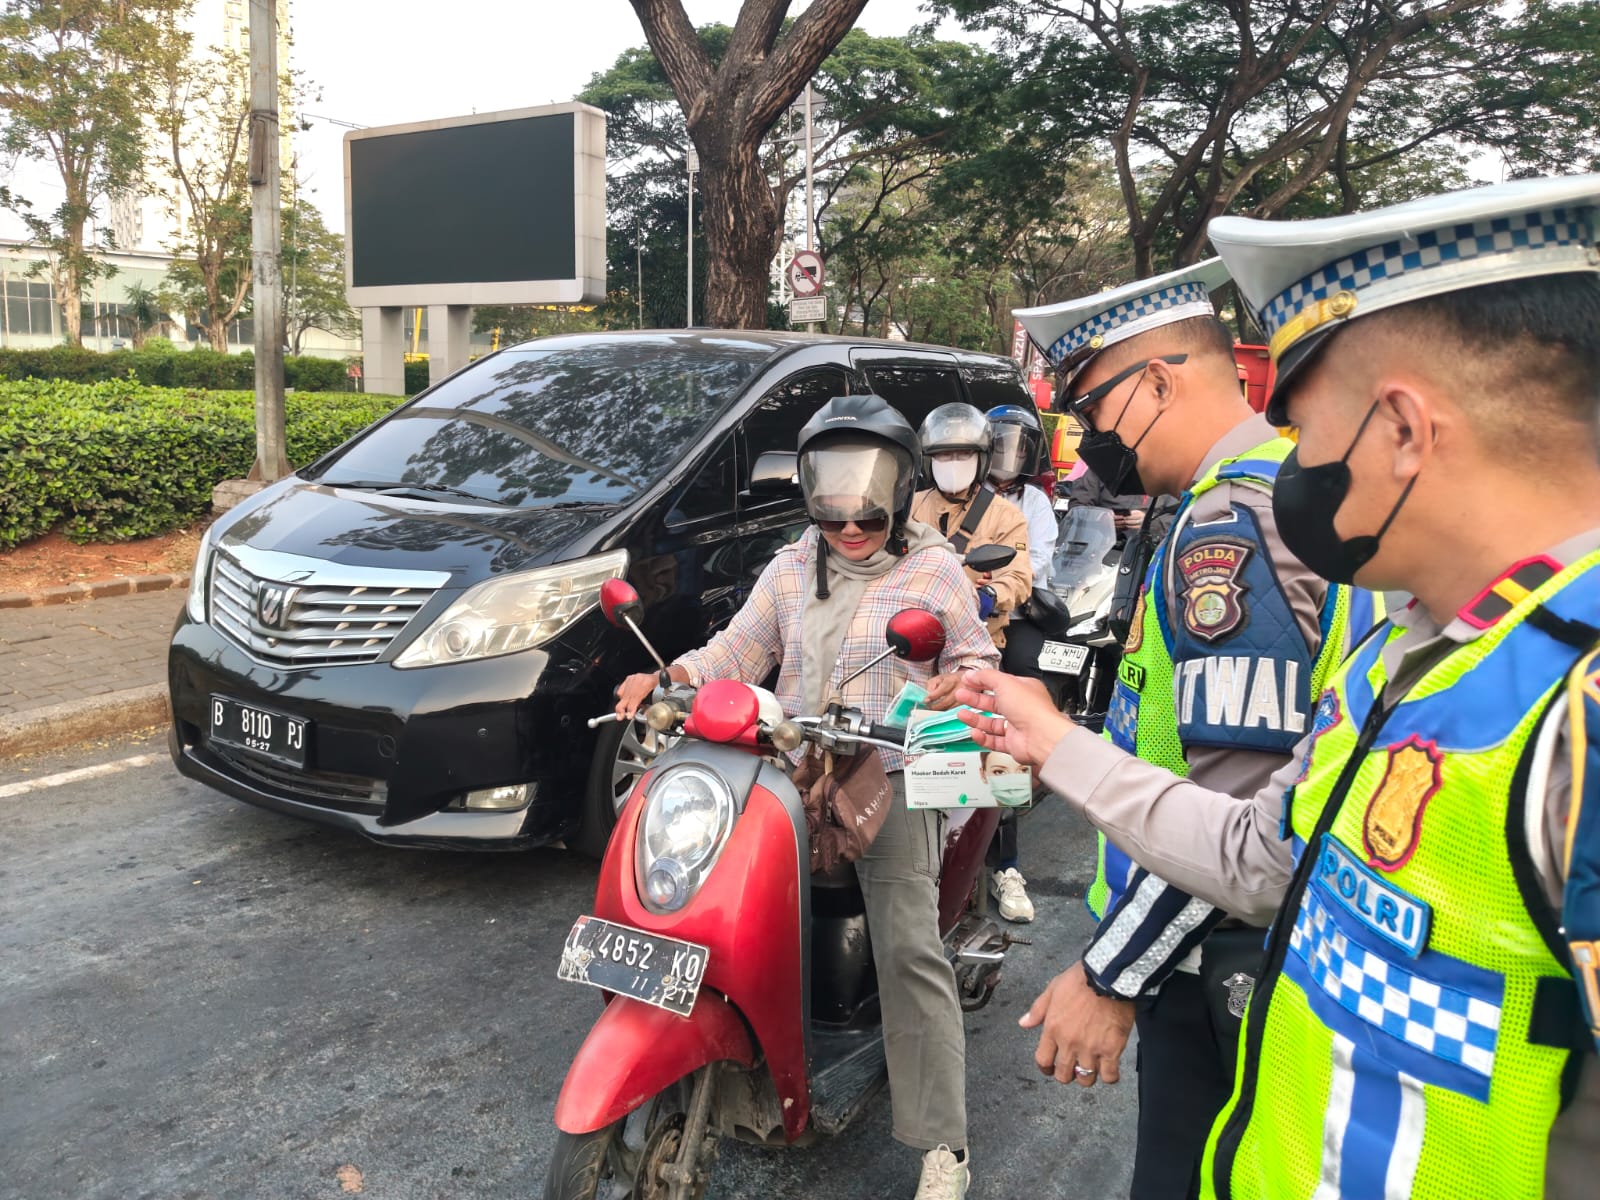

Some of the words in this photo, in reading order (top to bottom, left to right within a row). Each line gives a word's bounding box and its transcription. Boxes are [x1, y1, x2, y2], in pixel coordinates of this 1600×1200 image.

[1183, 549, 1236, 569] POLDA
[1120, 661, 1141, 685] LRI
[1174, 656, 1306, 733] TWAL
[214, 702, 224, 726] B
[241, 709, 272, 739] 8110
[287, 721, 303, 750] PJ
[1321, 850, 1414, 940] POLRI
[598, 932, 653, 970] 4852
